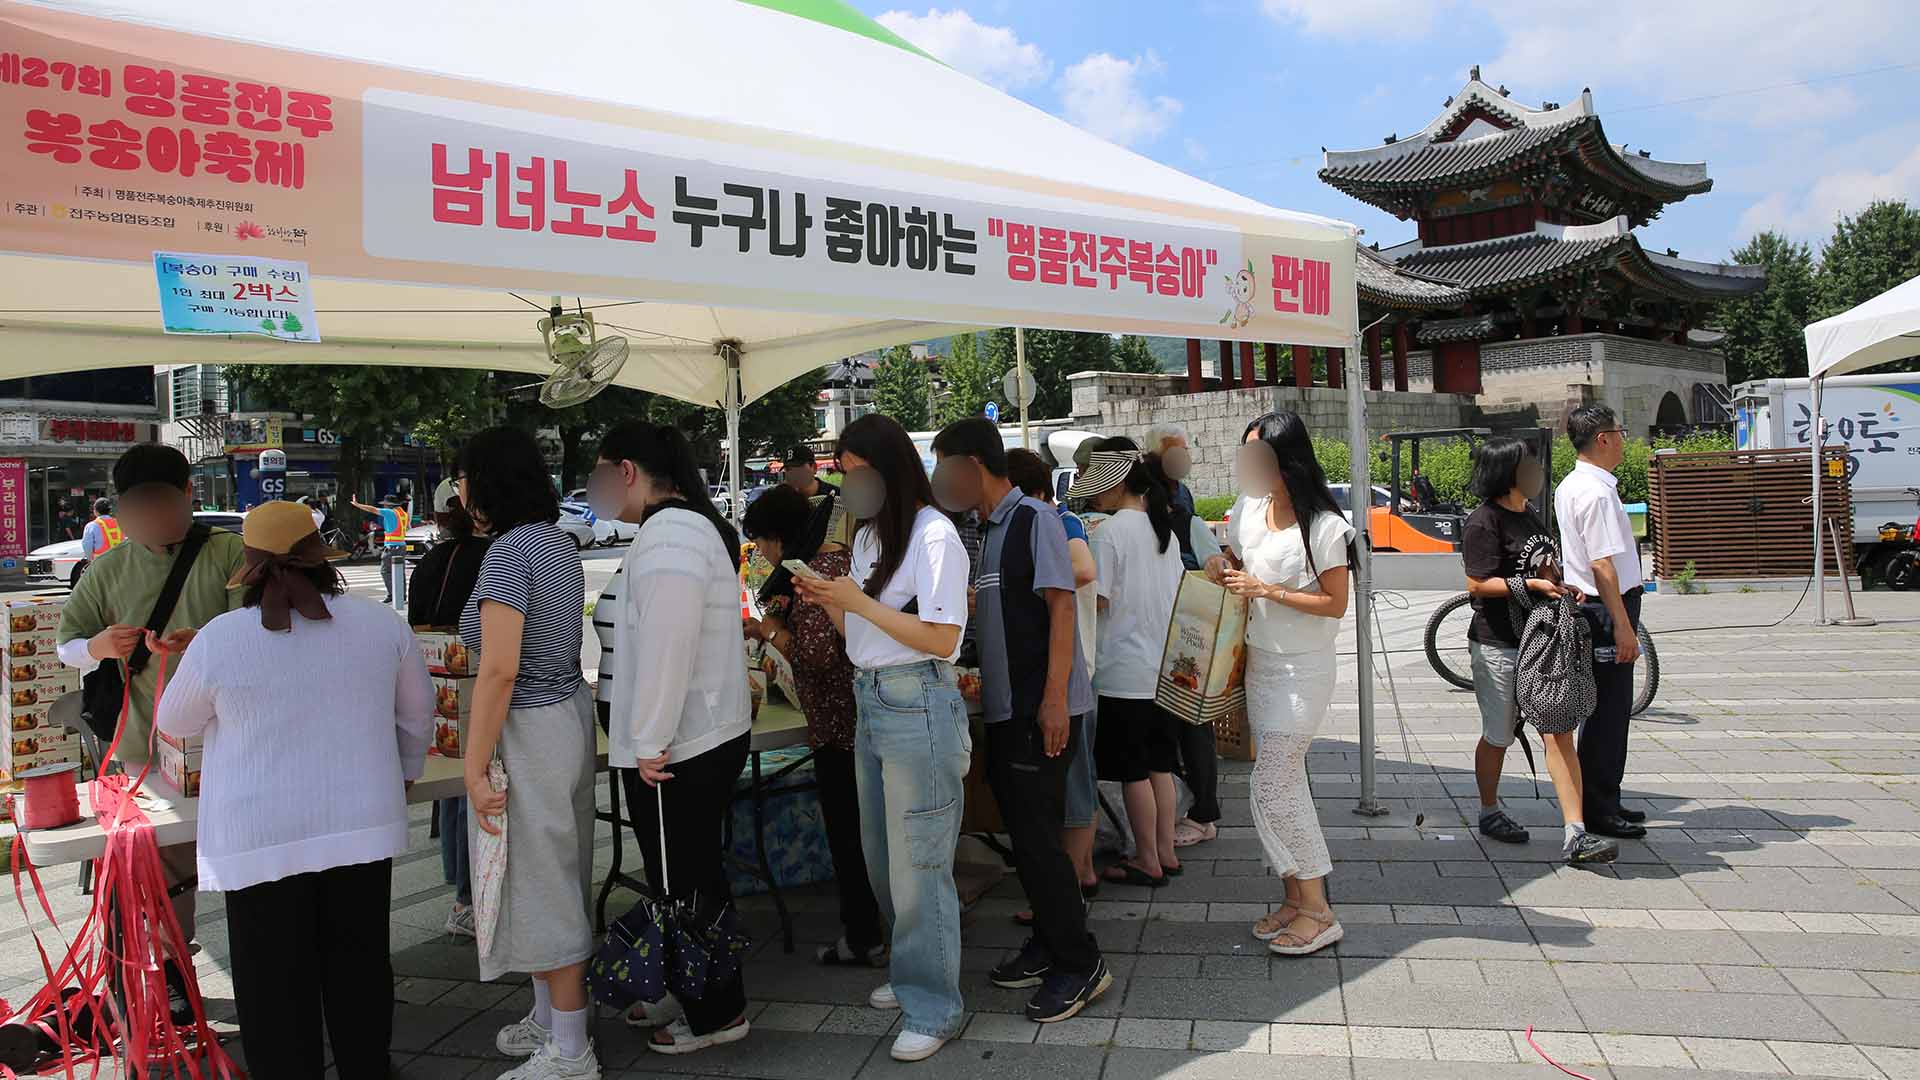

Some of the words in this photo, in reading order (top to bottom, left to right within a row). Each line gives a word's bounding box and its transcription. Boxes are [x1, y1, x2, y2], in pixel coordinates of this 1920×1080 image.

[124, 64, 334, 138] 명품전주
[24, 109, 304, 189] 복숭아축제
[82, 186, 104, 199] 주최
[15, 203, 37, 216] 주관
[69, 207, 176, 229] 전주농업협동조합
[205, 222, 223, 233] 후원
[432, 143, 656, 243] 남녀노소
[673, 176, 812, 258] 누구나
[824, 197, 977, 275] 좋아하는
[988, 218, 1217, 298] "명품전주복숭아"
[1272, 255, 1331, 316] 판매
[163, 261, 217, 276] [복숭아
[226, 265, 258, 278] 구매
[267, 268, 301, 283] 수량]
[172, 287, 192, 297] 1인
[200, 290, 225, 300] 최대
[232, 282, 299, 303] 2박스
[187, 304, 214, 313] 구매
[223, 306, 289, 320] 가능합니다!
[263, 456, 285, 466] 편의점
[262, 479, 284, 493] GS
[3, 479, 16, 542] 부라더미싱
[1515, 534, 1540, 570] LACOSTE
